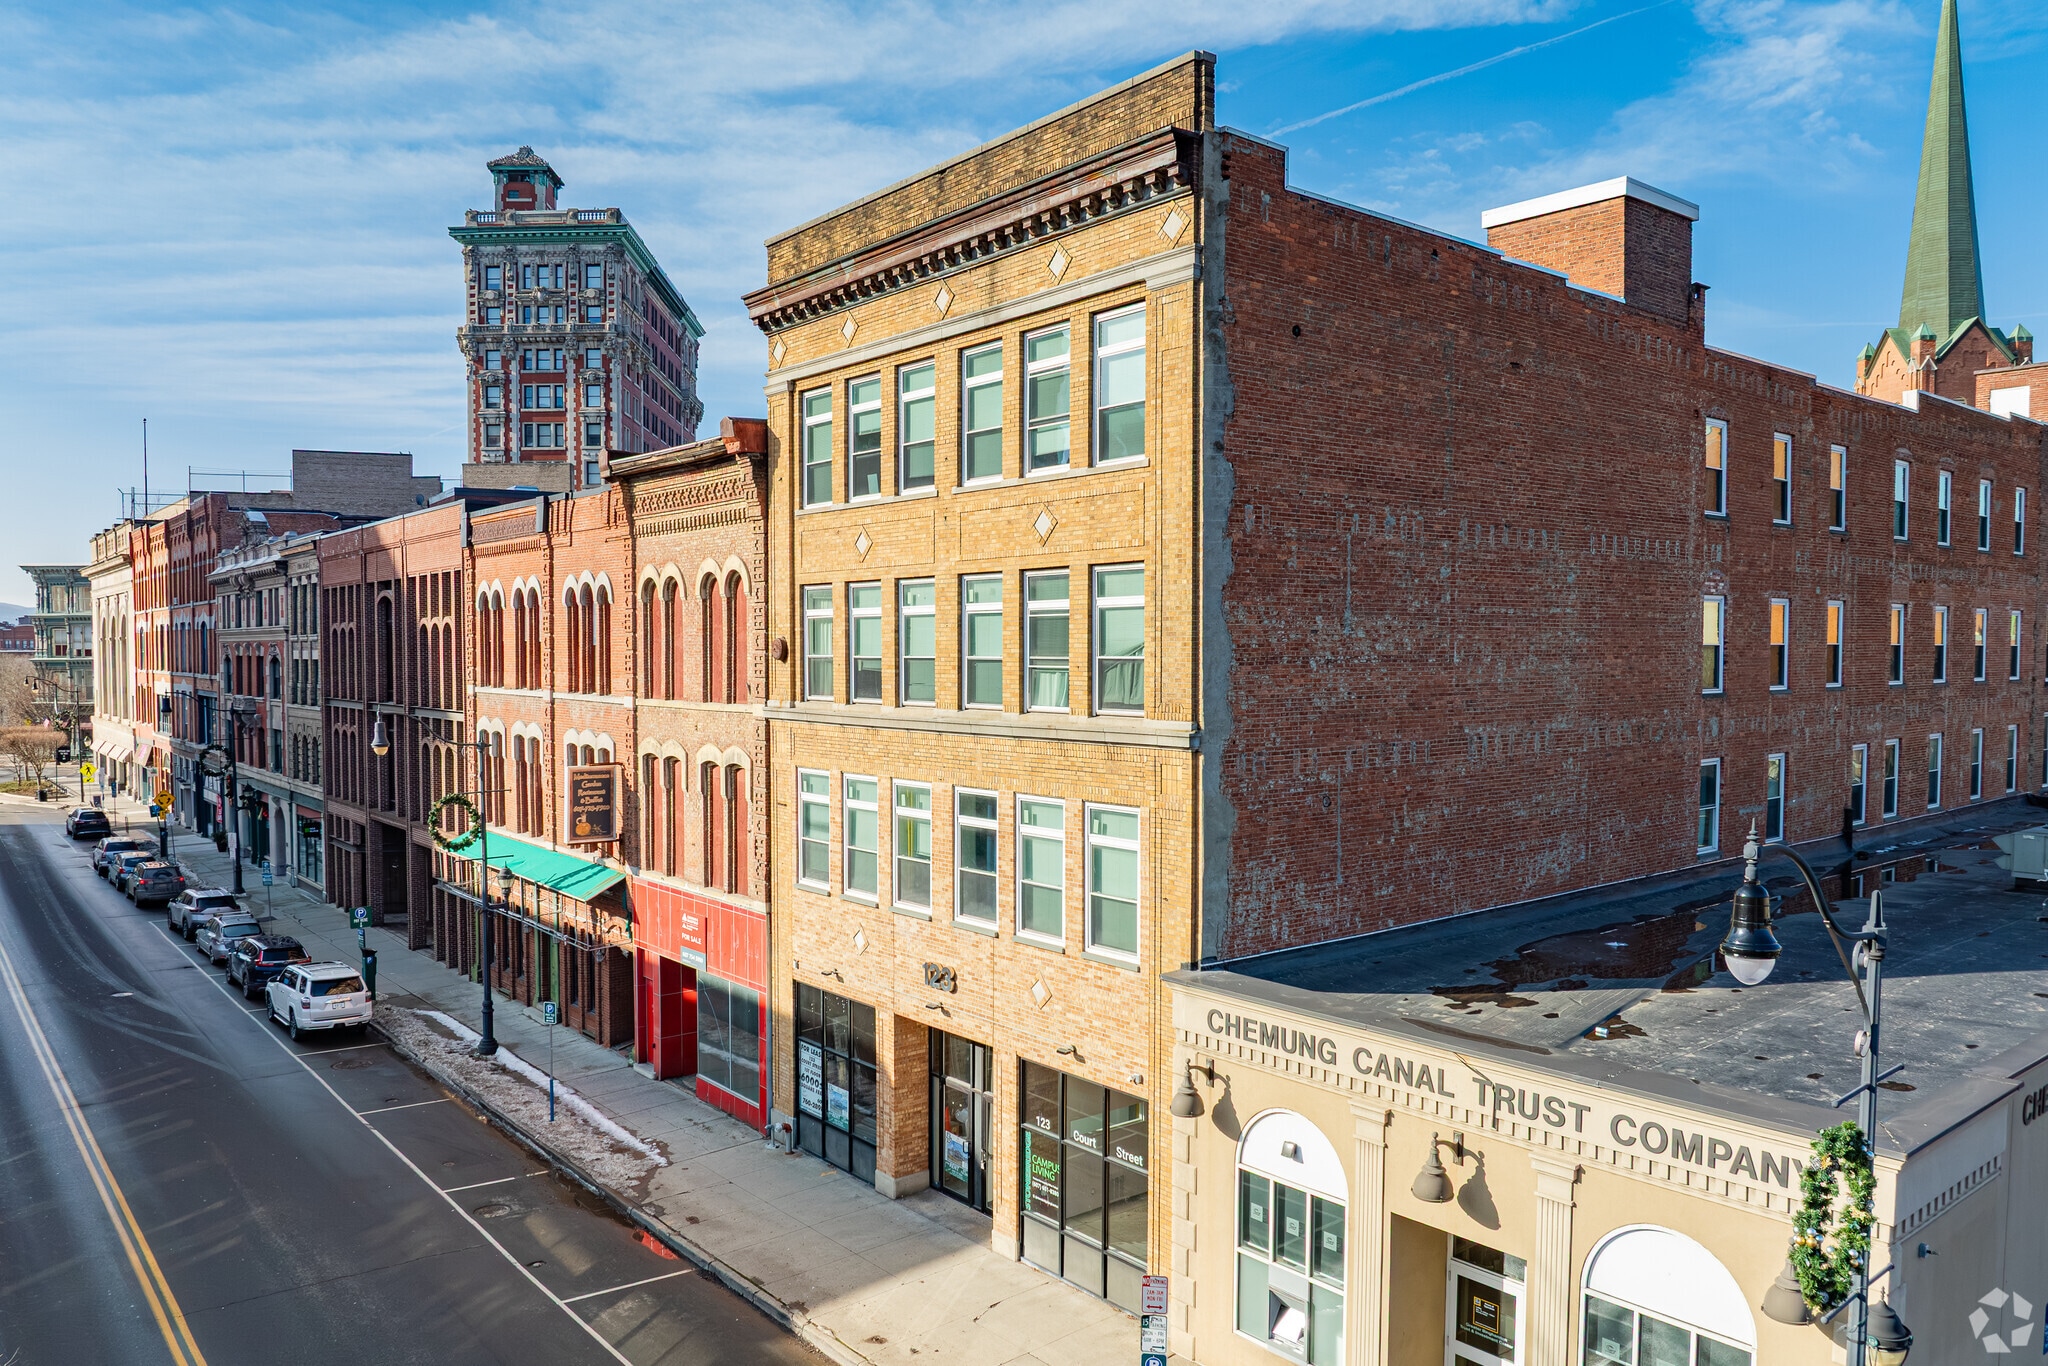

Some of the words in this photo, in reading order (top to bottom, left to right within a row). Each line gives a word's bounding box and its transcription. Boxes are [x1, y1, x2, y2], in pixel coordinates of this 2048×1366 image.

[681, 932, 690, 942] FOR
[690, 935, 702, 945] SALE
[922, 962, 953, 992] 123
[810, 1048, 821, 1058] LEAS
[1207, 1009, 1337, 1066] CHEMUNG
[1352, 1048, 1455, 1099] CANAL
[1472, 1077, 1591, 1133] TRUST
[1036, 1116, 1050, 1130] 123
[1073, 1130, 1097, 1148] Court
[1116, 1146, 1144, 1166] Street
[1032, 1163, 1056, 1182] LIVING
